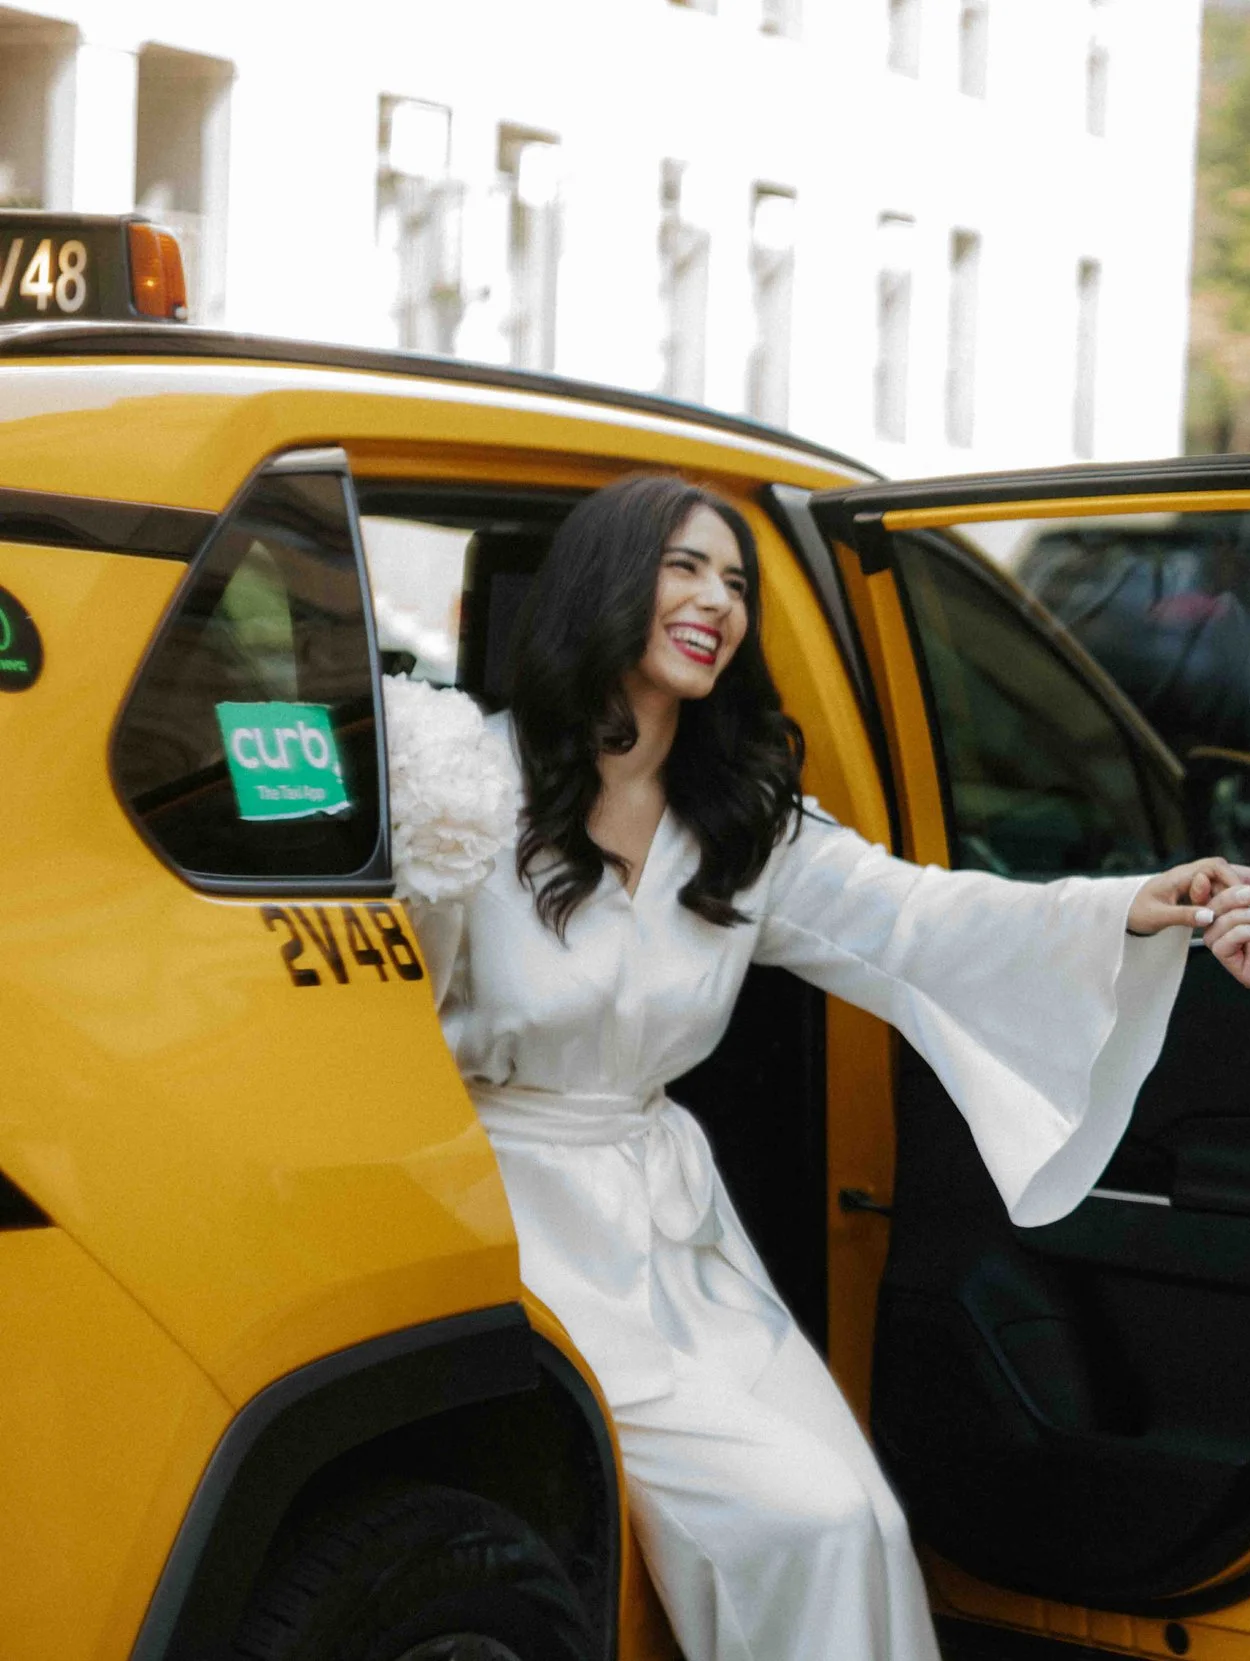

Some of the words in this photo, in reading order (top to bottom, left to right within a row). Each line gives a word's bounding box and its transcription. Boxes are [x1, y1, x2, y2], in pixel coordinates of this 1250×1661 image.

[231, 720, 330, 769] curb
[255, 785, 280, 801] The
[260, 902, 424, 987] 2V48
